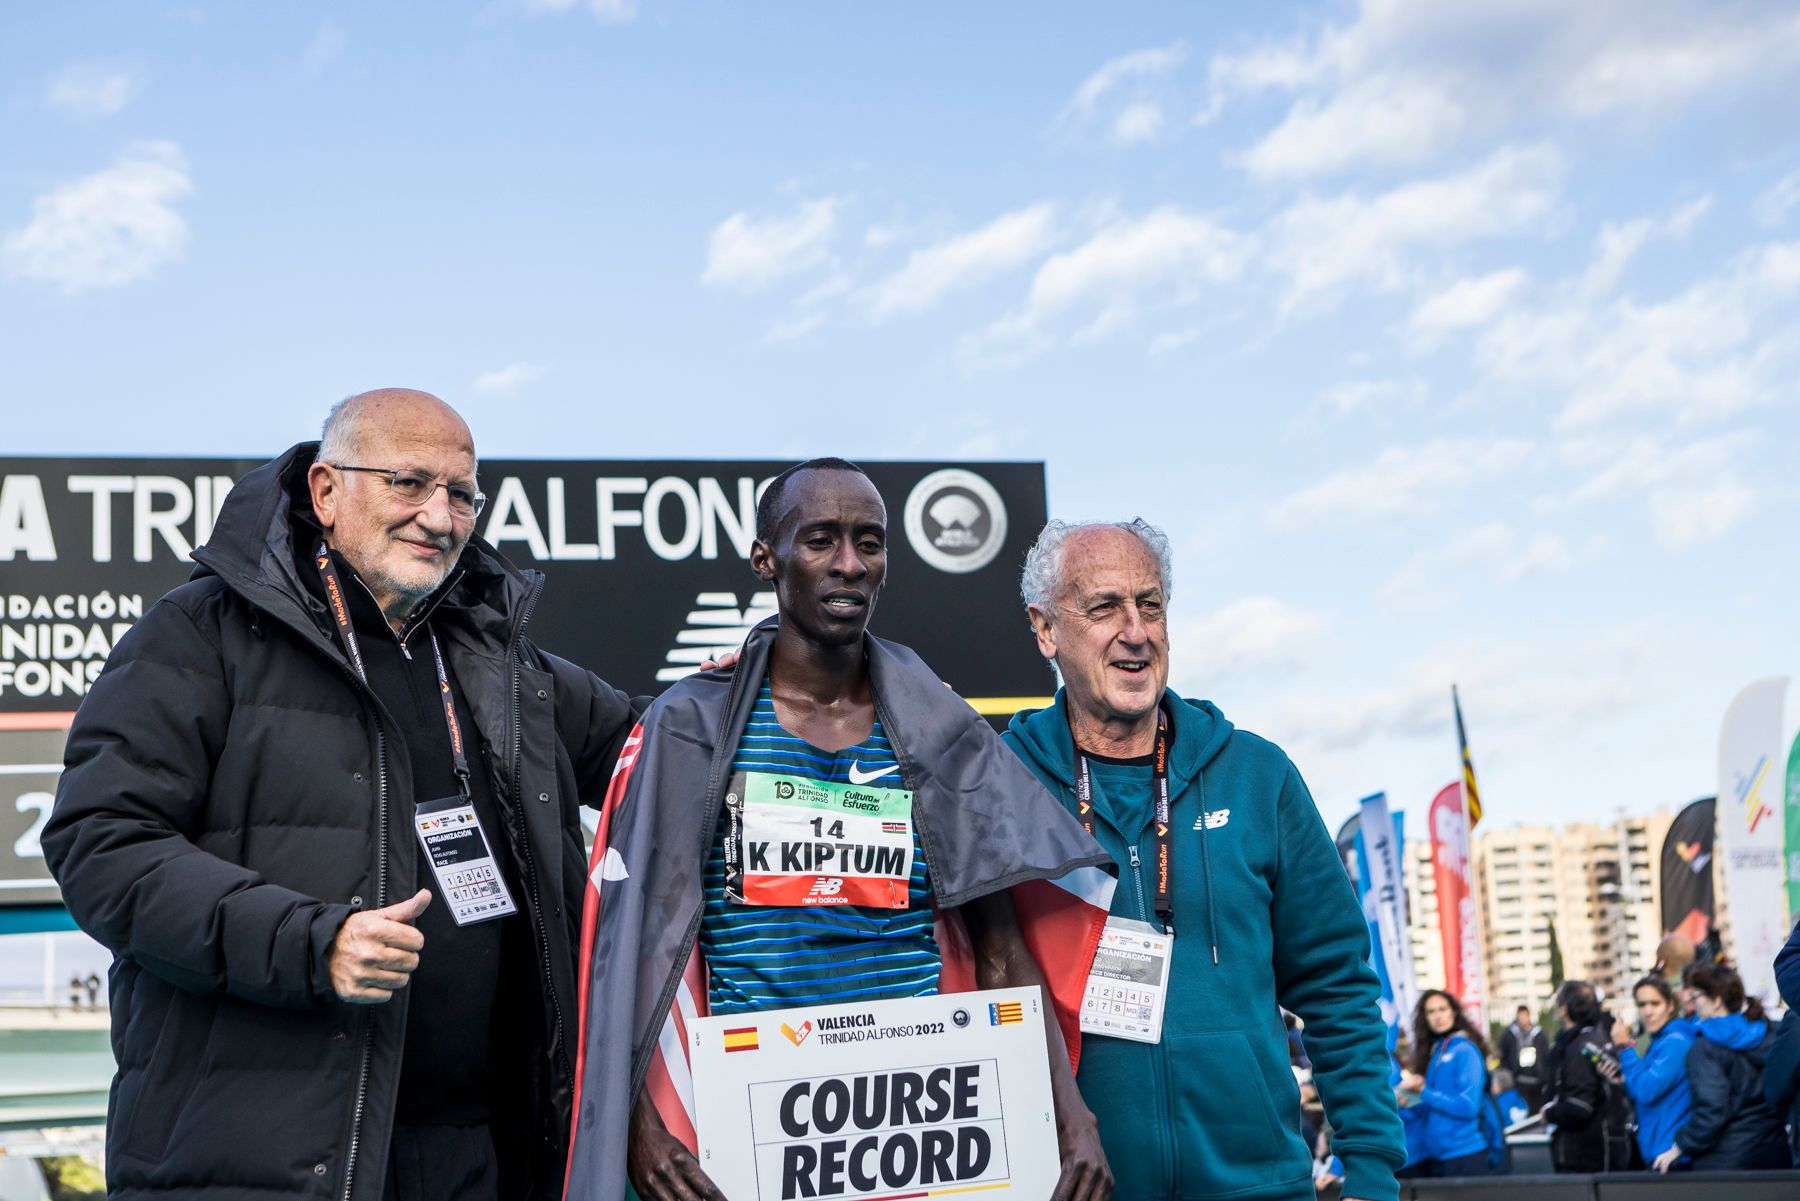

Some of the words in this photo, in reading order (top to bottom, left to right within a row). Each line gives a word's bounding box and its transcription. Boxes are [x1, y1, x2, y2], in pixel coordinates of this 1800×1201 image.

[483, 476, 777, 561] ALFON
[0, 590, 143, 619] DACIÓN
[326, 575, 347, 626] #MadeToRun
[797, 788, 829, 799] TRINIDAD
[797, 795, 829, 804] ALFONSO
[844, 790, 874, 802] Cultura
[842, 799, 880, 812] Esfuerzo
[427, 829, 473, 844] ORGANIZACIÓN
[810, 817, 845, 839] 14
[724, 837, 732, 864] VALENCIA
[730, 842, 738, 864] TRINIDAD
[749, 841, 771, 872] K
[781, 842, 906, 876] KIPTUM
[1159, 843, 1168, 894] #MadeToRun
[447, 878, 453, 886] 1
[456, 875, 462, 884] 2
[466, 873, 472, 881] 3
[476, 871, 482, 879] 4
[485, 869, 491, 877] 5
[453, 891, 460, 899] 6
[463, 889, 468, 898] 7
[473, 887, 479, 896] 8
[802, 896, 817, 905] new
[818, 895, 848, 905] balance
[1103, 971, 1131, 981] DIRECTOR
[1090, 986, 1095, 994] 1
[1103, 988, 1109, 996] 2
[1116, 990, 1123, 999] 3
[1144, 995, 1150, 1003] 5
[1087, 1000, 1094, 1008] 6
[1101, 1002, 1108, 1010] 7
[1114, 1004, 1121, 1012] 8
[817, 1014, 875, 1030] VALENCIA
[818, 1029, 865, 1045] TRINIDAD
[866, 1025, 914, 1041] ALFONSO
[915, 1022, 945, 1036] 2022
[779, 1064, 981, 1138] COURSE
[781, 1125, 992, 1200] RECORD
